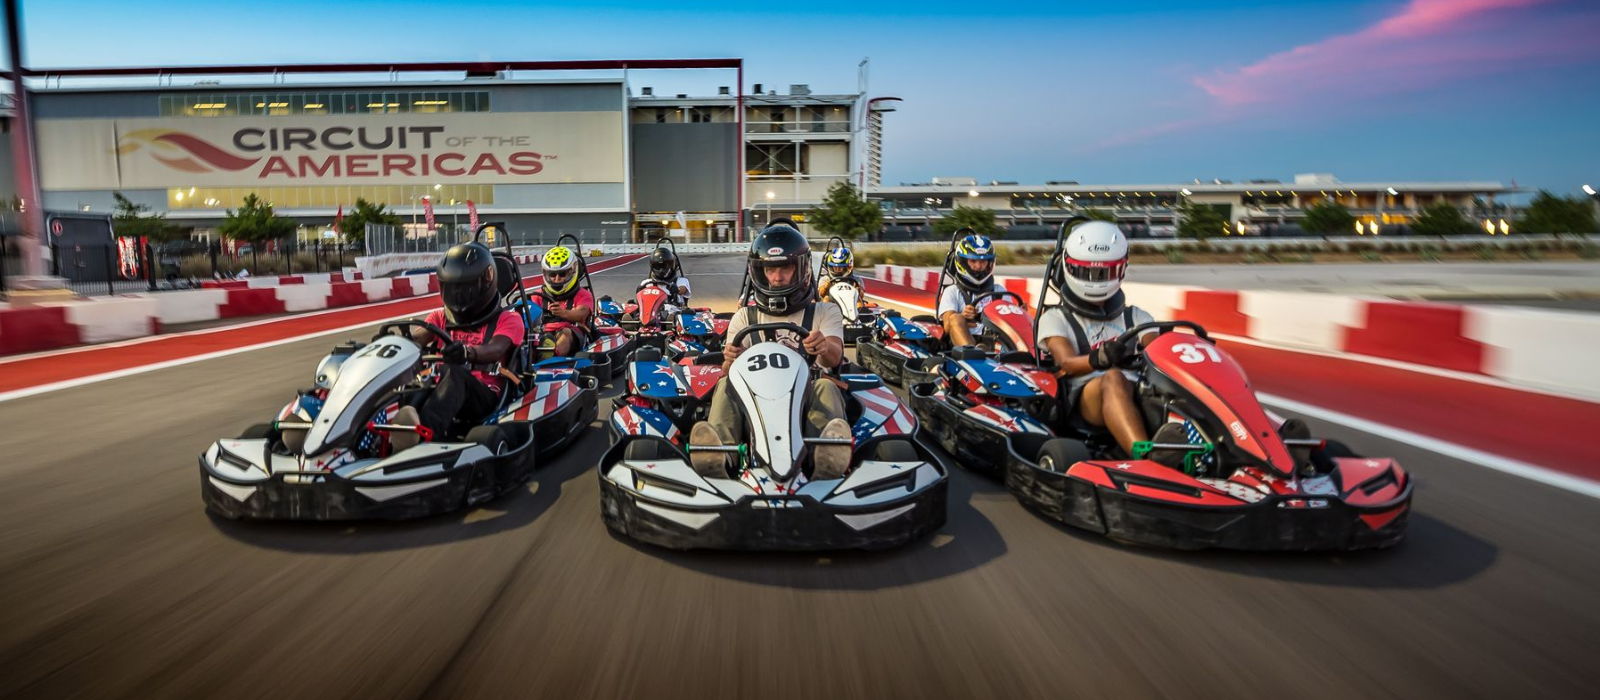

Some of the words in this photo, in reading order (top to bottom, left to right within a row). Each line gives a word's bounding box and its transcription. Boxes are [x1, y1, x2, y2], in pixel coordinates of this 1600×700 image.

[233, 126, 445, 151] CIRCUIT
[446, 136, 477, 147] OF
[483, 136, 530, 147] THE
[258, 152, 543, 177] AMERICAS
[366, 344, 402, 359] 26
[1171, 343, 1222, 363] 37
[747, 353, 791, 371] 30
